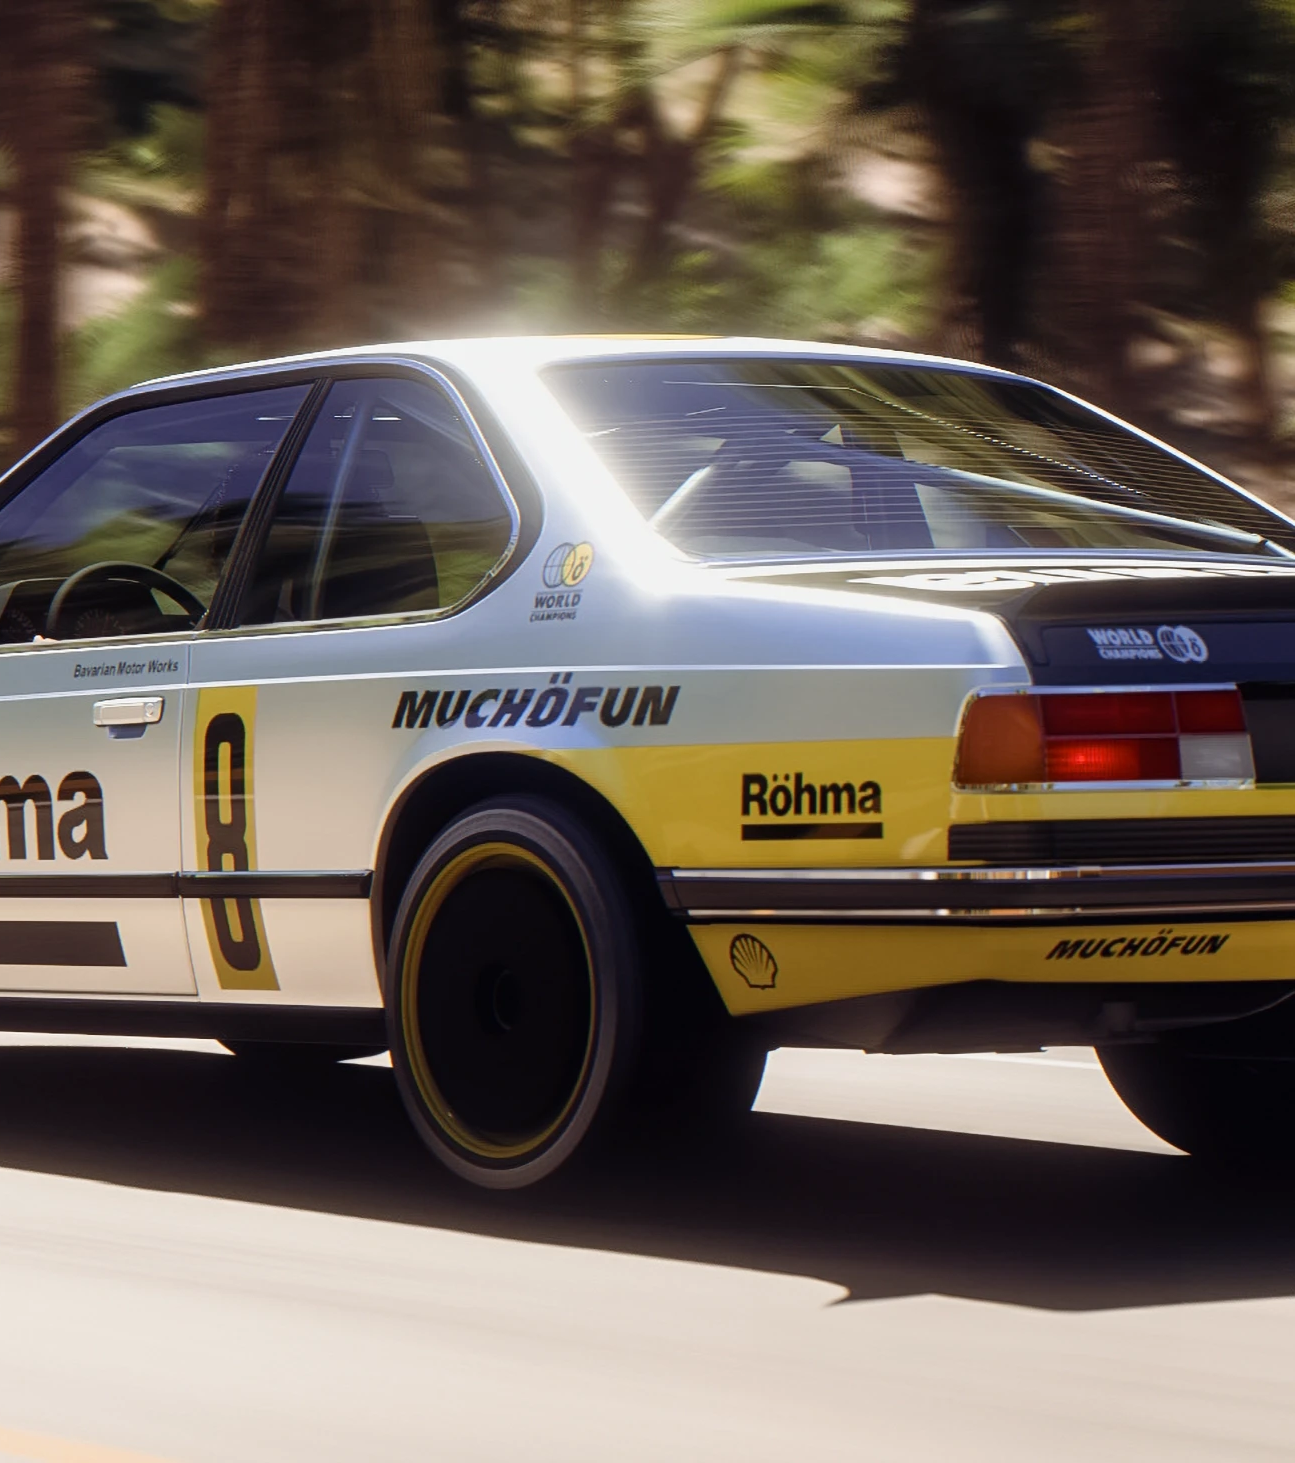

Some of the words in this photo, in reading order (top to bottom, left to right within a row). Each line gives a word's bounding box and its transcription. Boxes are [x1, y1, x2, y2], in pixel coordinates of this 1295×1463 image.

[534, 593, 582, 609] WORLD
[529, 610, 577, 623] CHAMPIONS
[1086, 627, 1154, 645] WORLD
[73, 662, 116, 679] Bavarian
[116, 660, 145, 676] Motor
[148, 658, 180, 674] Works
[391, 672, 681, 729] MUCHÖFUN
[741, 772, 883, 817] Röhma
[1045, 928, 1231, 961] MUCHÖFUN
